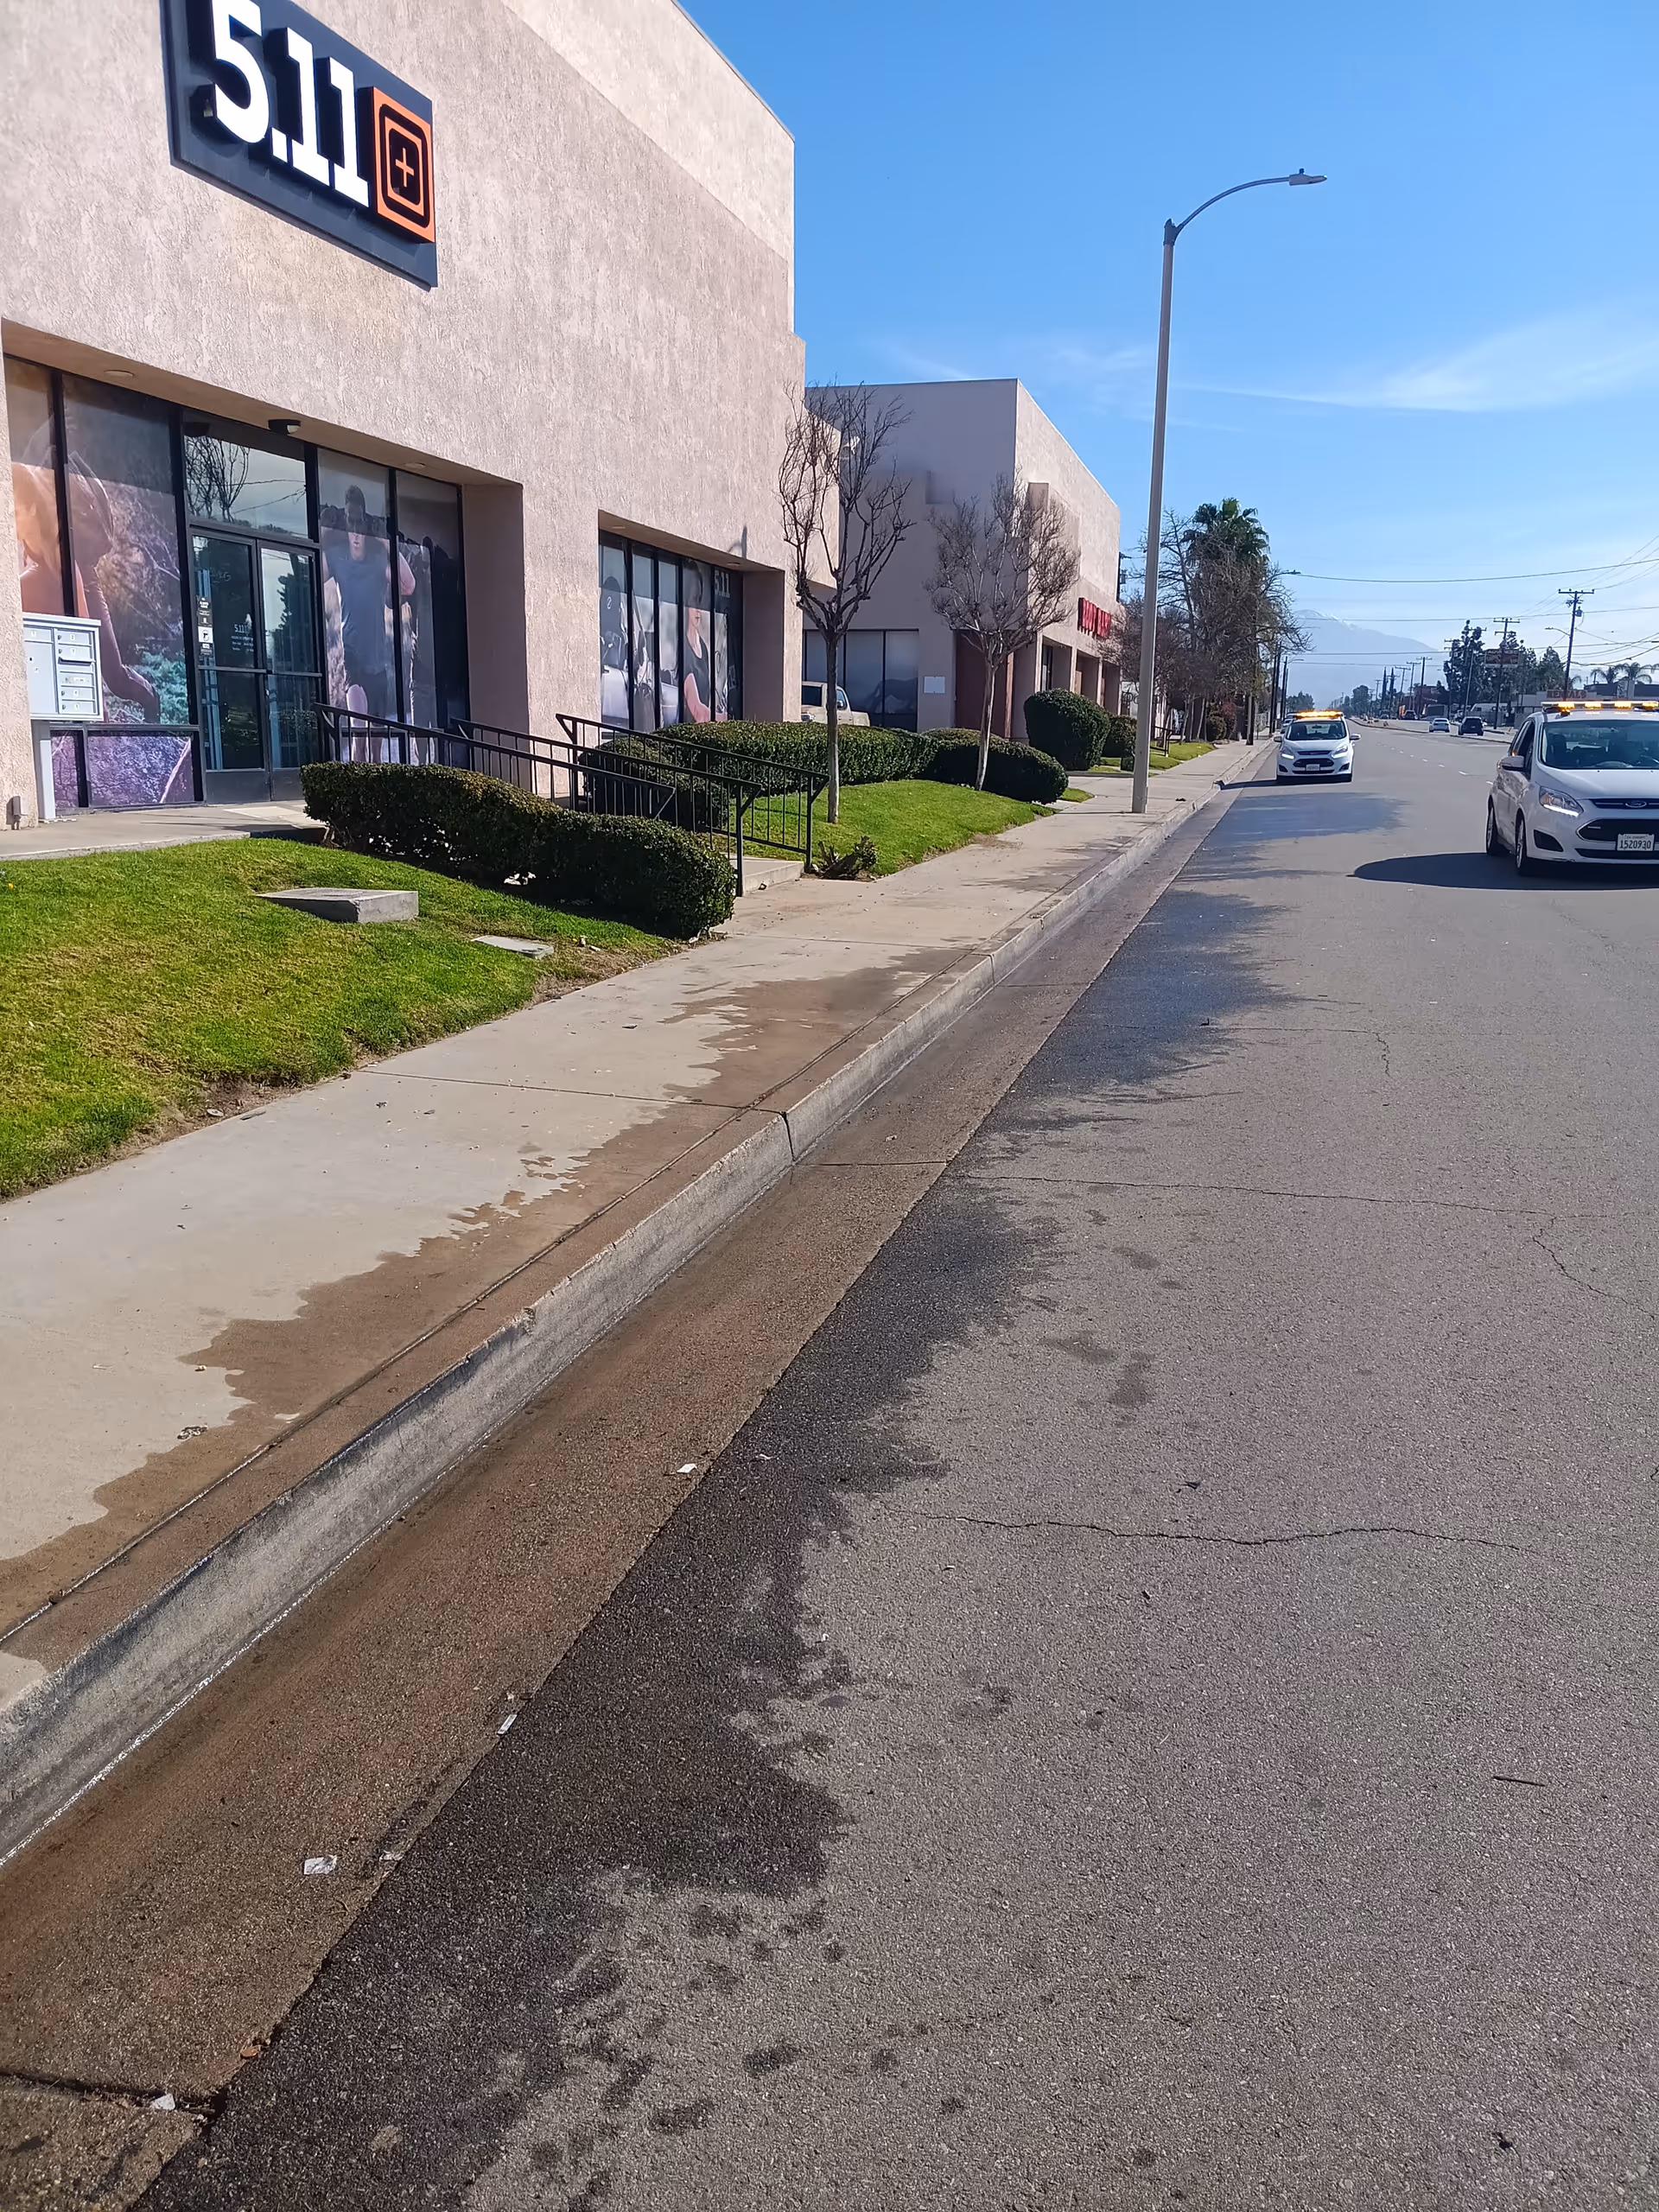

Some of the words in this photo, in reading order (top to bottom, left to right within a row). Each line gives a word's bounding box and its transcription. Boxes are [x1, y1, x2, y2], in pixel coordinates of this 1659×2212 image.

[213, 0, 370, 208] 5.11
[714, 569, 730, 599] 5.11
[1619, 839, 1651, 849] 1520930
